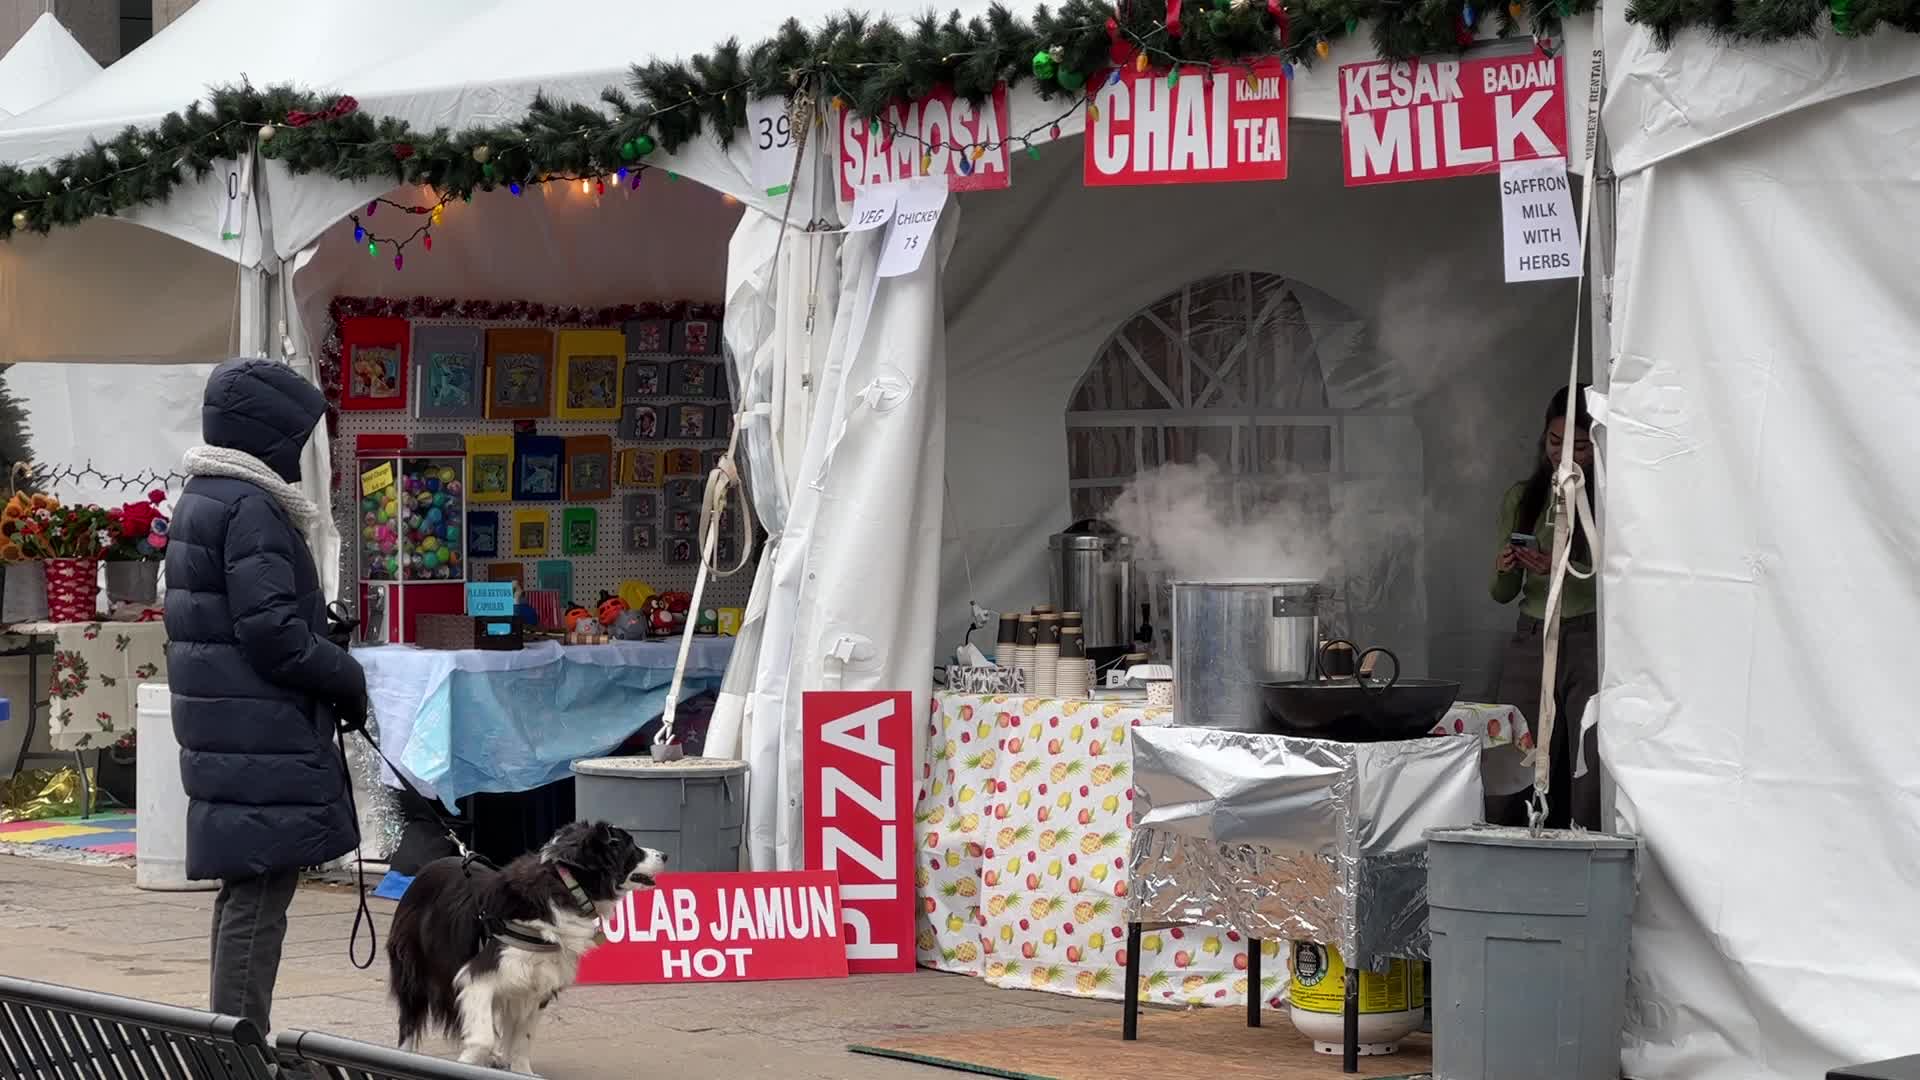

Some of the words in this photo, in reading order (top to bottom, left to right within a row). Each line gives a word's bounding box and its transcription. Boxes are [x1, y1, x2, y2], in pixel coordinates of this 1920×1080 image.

[1344, 61, 1464, 113] KESAR
[1483, 58, 1556, 94] BADAM
[1589, 49, 1602, 103] RENTALS
[759, 115, 791, 150] 39
[843, 94, 1004, 189] SAMOSA
[1093, 73, 1229, 175] CHAI
[1233, 117, 1281, 163] TEA
[1349, 90, 1561, 178] MILK
[1503, 176, 1567, 195] SAFFRON
[858, 209, 884, 225] VEG
[897, 210, 939, 226] CHICKEN
[1521, 202, 1557, 219] MILK
[903, 235, 919, 250] 7$
[1523, 228, 1562, 244] WITH
[1519, 253, 1570, 271] HERBS
[821, 698, 898, 960] PIZZA
[601, 888, 700, 943] ULAB
[709, 886, 837, 942] JAMUN
[661, 948, 752, 979] HOT
